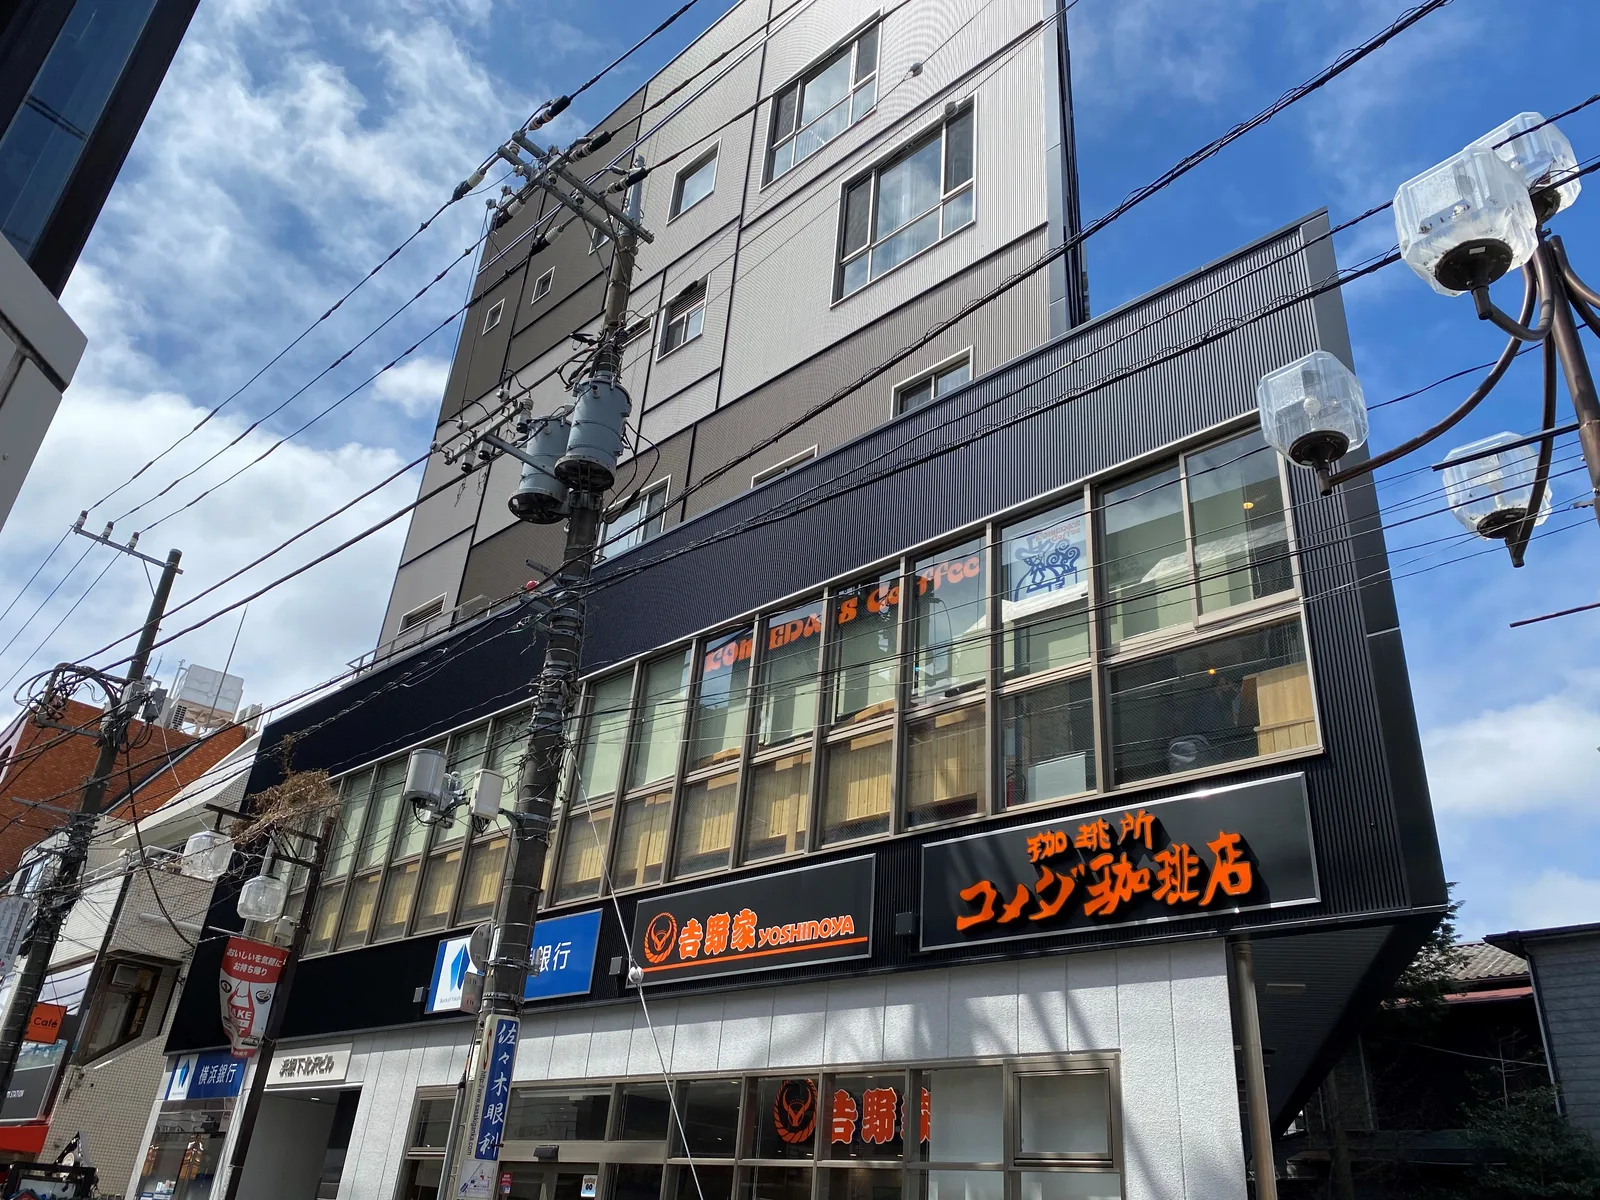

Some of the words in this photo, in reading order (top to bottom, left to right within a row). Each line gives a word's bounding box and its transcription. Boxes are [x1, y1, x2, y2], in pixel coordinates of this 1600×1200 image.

[704, 597, 857, 672] KOMEDAS
[1026, 809, 1155, 863] 珈琲所
[956, 830, 1253, 931] コメダ珈琲店
[678, 908, 758, 960] 吉野家
[758, 914, 854, 948] YOSHINOYA
[34, 1016, 57, 1028] Café
[198, 1063, 238, 1085] 横浜銀行
[479, 1023, 516, 1158] 佐々木眼科
